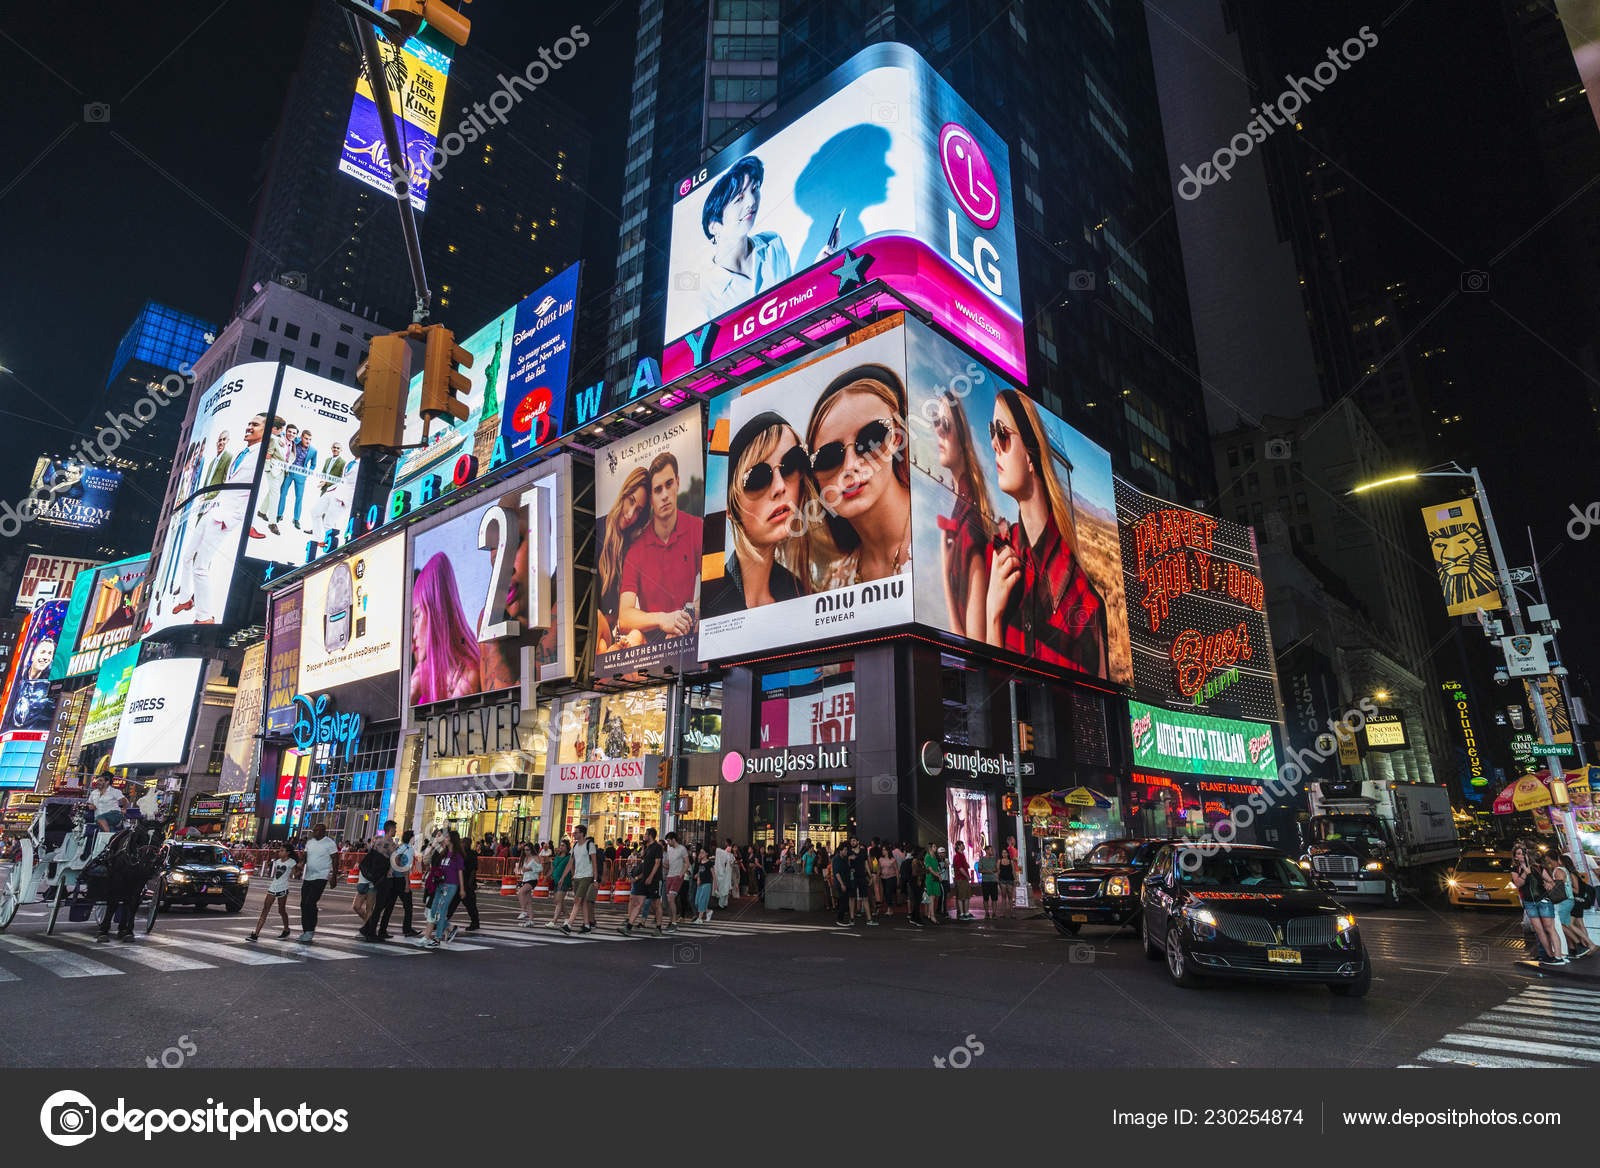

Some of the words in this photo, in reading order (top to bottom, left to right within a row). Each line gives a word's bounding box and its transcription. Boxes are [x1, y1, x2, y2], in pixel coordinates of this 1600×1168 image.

[410, 80, 436, 104] LION
[415, 73, 434, 88] THE
[405, 92, 437, 120] KING
[691, 168, 708, 188] LG
[947, 208, 1003, 296] LG
[535, 309, 558, 331] CRUISE
[558, 298, 574, 318] LINE
[733, 315, 755, 342] LG
[539, 351, 553, 367] New
[553, 340, 567, 356] York
[391, 321, 720, 520] BROADWAY
[637, 434, 661, 452] POLO
[61, 496, 82, 506] THE
[1135, 510, 1218, 582] PLANET
[477, 486, 553, 644] 21
[815, 611, 856, 626] EYEWEAR
[79, 634, 104, 654] PLAY
[66, 650, 100, 677] MINI
[272, 648, 299, 673] COME
[306, 660, 325, 673] Discover
[604, 652, 621, 663] LIVE
[129, 697, 166, 714] EXPRESS
[268, 685, 297, 710] AWAY
[426, 702, 521, 759] FOREVER
[1156, 721, 1208, 761] AUTHENTIC
[1207, 729, 1247, 764] ITALIAN
[745, 749, 816, 778] sunglass
[819, 745, 848, 769] hut
[1532, 745, 1572, 755] Broadway
[560, 765, 579, 782] U.S.
[580, 763, 612, 781] POLO
[945, 750, 1000, 779] sunglass
[577, 782, 601, 790] SINCE
[603, 780, 625, 789] 1890
[1200, 782, 1227, 793] PLANET
[435, 793, 474, 811] FOREVER
[477, 792, 487, 810] 21
